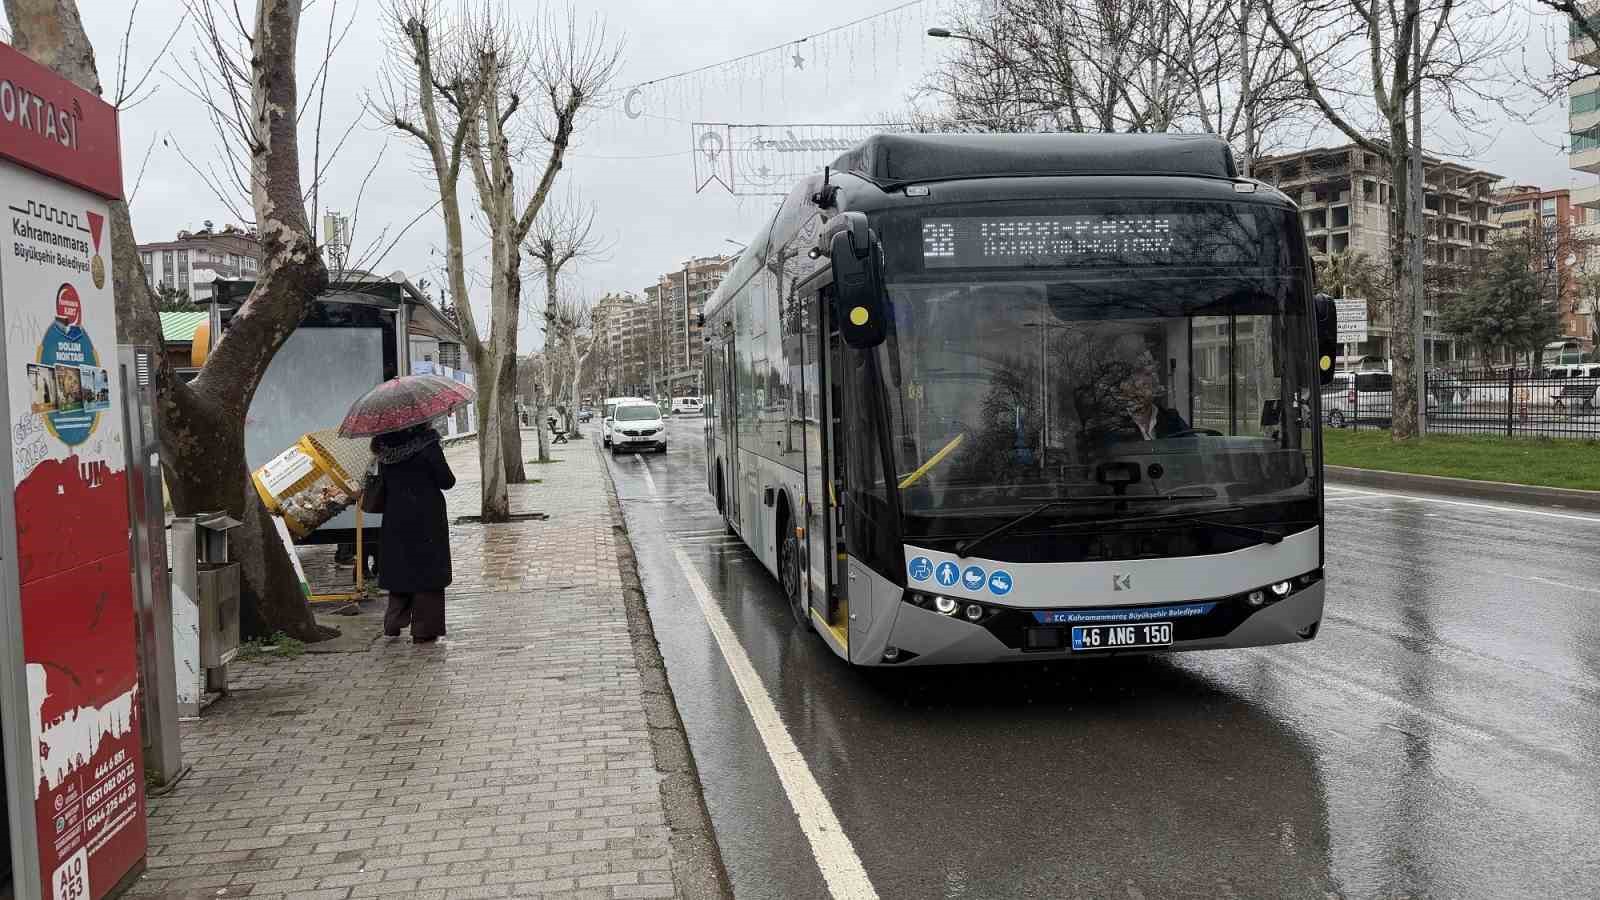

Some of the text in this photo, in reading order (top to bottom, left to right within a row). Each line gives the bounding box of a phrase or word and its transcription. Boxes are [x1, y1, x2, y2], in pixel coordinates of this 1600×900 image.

[12, 217, 90, 258] Kahramanmaraş
[14, 242, 90, 273] Büyükşehir Belediyesi
[1054, 606, 1204, 623] T.C. Kahramanmaraş Büyükşehir Belediyesi
[1082, 627, 1100, 647] 46
[1108, 626, 1136, 646] ANG
[1143, 624, 1170, 644] 150
[86, 787, 103, 809] 0531
[60, 857, 82, 890] ALO
[61, 877, 83, 900] 153
